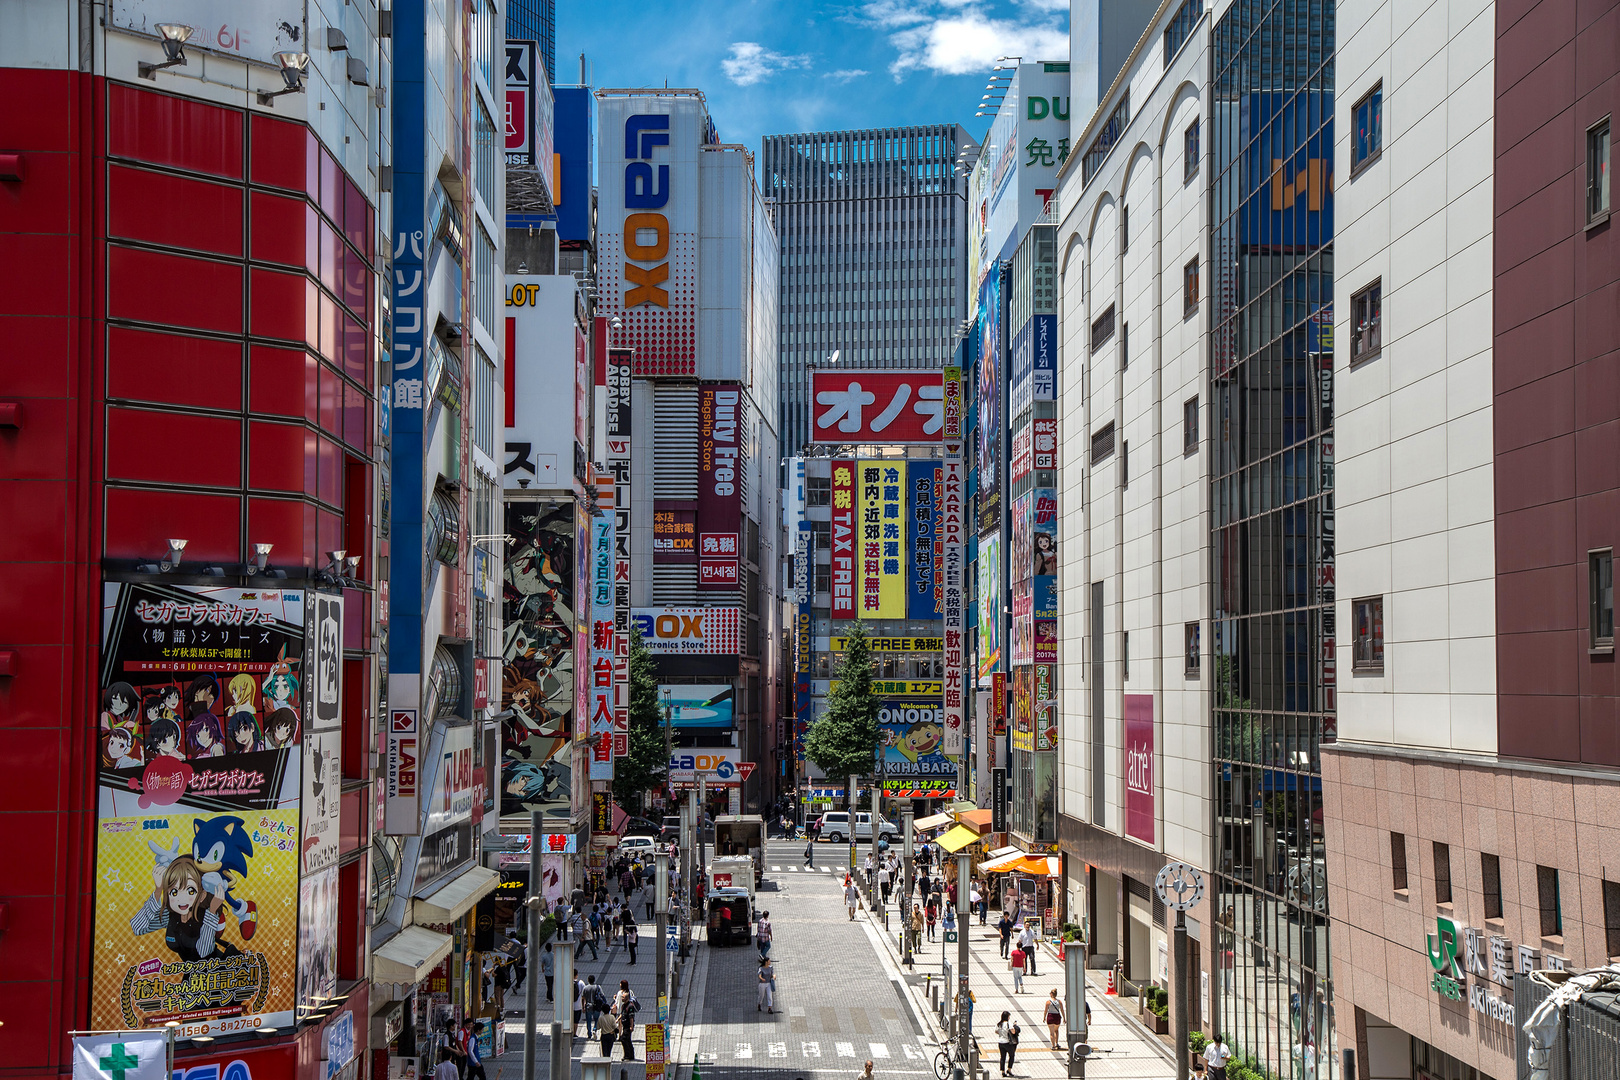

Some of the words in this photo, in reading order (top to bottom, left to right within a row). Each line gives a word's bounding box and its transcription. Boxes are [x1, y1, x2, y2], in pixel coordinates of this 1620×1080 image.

[394, 230, 423, 409] パソコン館
[1038, 317, 1049, 367] レオパレス21
[619, 354, 631, 407] HOBBY
[1035, 383, 1051, 394] 7F
[701, 391, 713, 437] Flagship
[713, 391, 738, 443] Duty
[946, 381, 961, 434] まんが喫茶
[702, 440, 713, 471] Store
[714, 446, 738, 496] Free
[1037, 456, 1051, 467] 6F
[834, 467, 851, 510] 免税
[946, 463, 960, 543] TAKARADA
[654, 512, 674, 522] 本店
[654, 523, 694, 534] 総合家電
[834, 512, 852, 552] TAX
[915, 478, 931, 594] お見積り無料です
[703, 536, 735, 553] 免税
[702, 565, 735, 578] 면세점
[799, 530, 811, 604] Panasonic
[834, 557, 852, 611] FREE
[136, 601, 276, 625] セガコラボカフェ
[283, 594, 300, 602] SEGA
[946, 588, 960, 627] 免税商店
[681, 640, 704, 650] Store
[799, 613, 809, 673] ONODEN
[872, 639, 911, 650] FREE
[872, 682, 907, 693] 冷蔵庫
[945, 630, 961, 708] 歓迎光臨
[592, 619, 614, 762] 新台入替
[188, 771, 265, 791] セガコラボカフェ
[389, 738, 397, 798] AKIHABARA
[398, 738, 416, 797] LABI
[453, 748, 472, 793] LABI
[143, 819, 170, 830] SEGA
[259, 816, 295, 836] あそんで
[1427, 915, 1465, 980] JR
[163, 990, 235, 1012] キャンペーン
[647, 1031, 663, 1052] 薬
